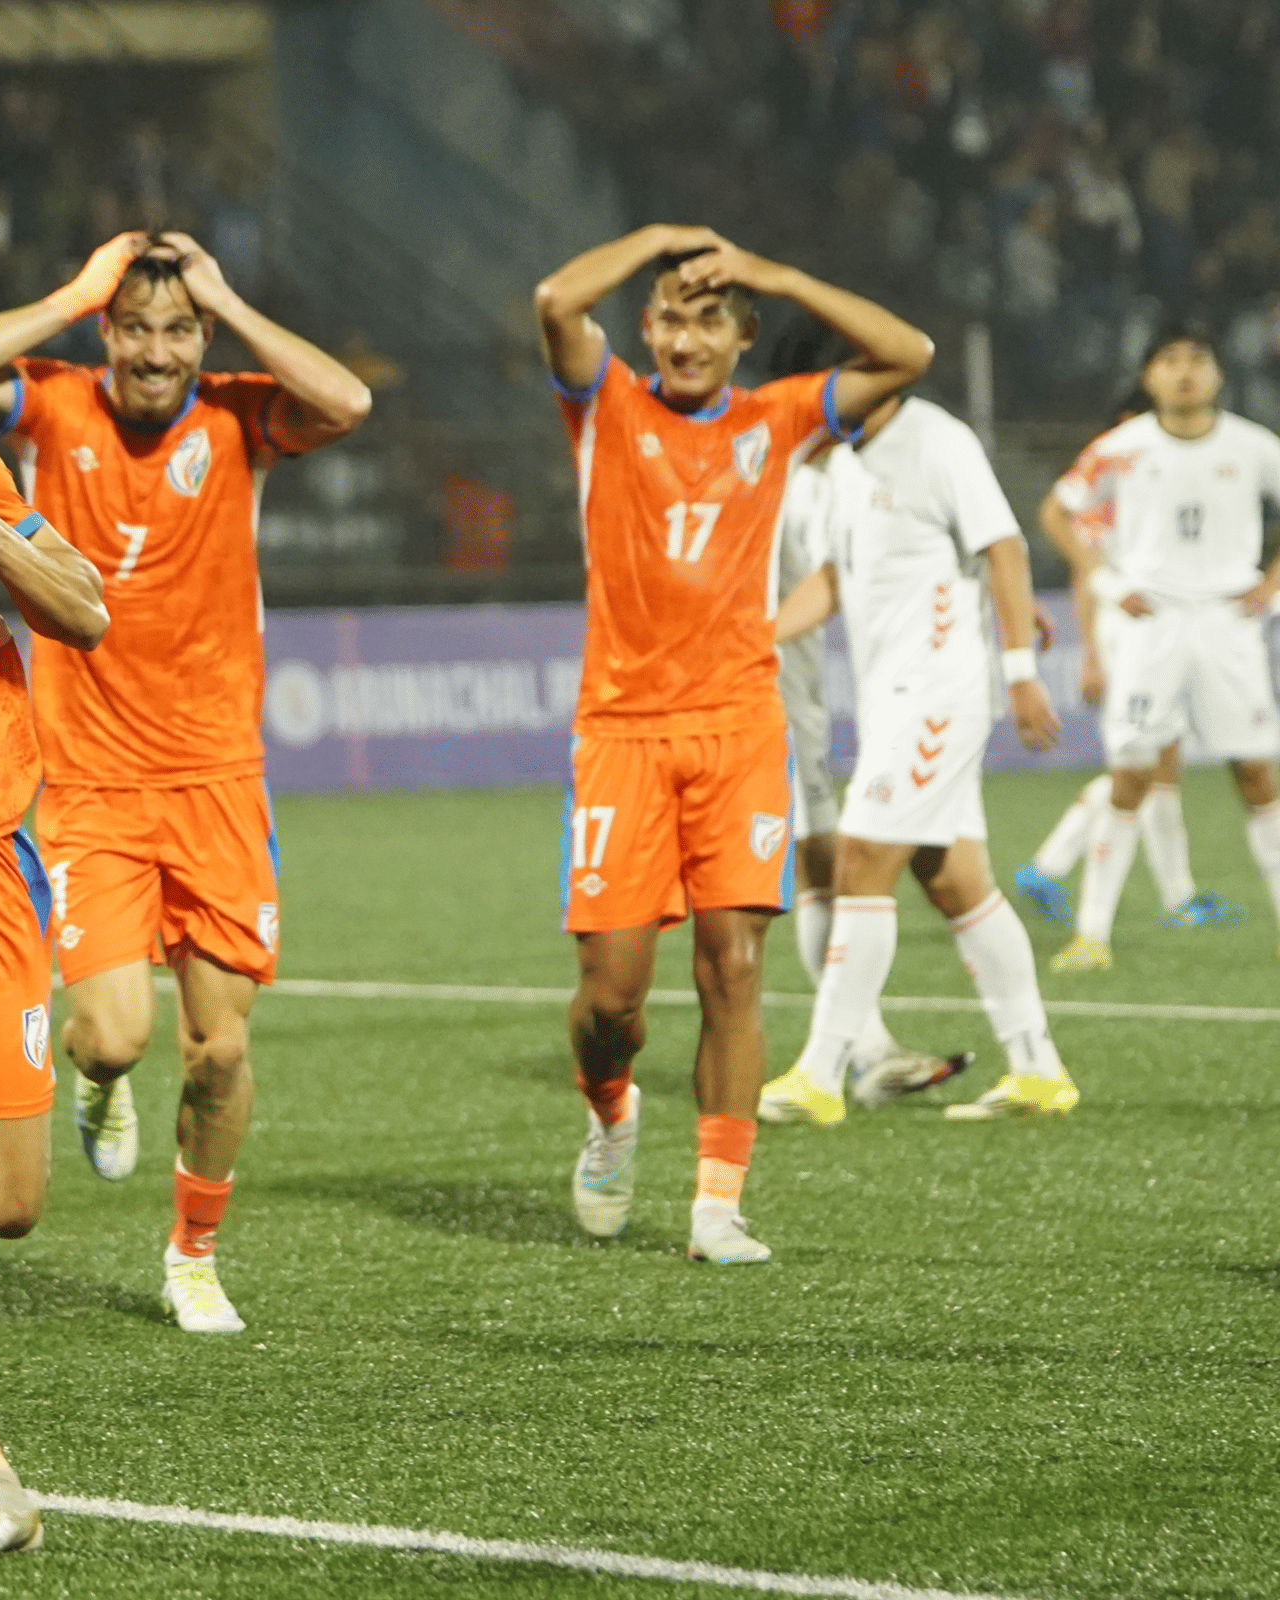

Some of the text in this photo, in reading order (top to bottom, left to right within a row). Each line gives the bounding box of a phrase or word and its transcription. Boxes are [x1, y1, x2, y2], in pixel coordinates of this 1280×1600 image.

[115, 520, 148, 579] 7
[664, 500, 722, 562] 17
[573, 806, 617, 869] 17
